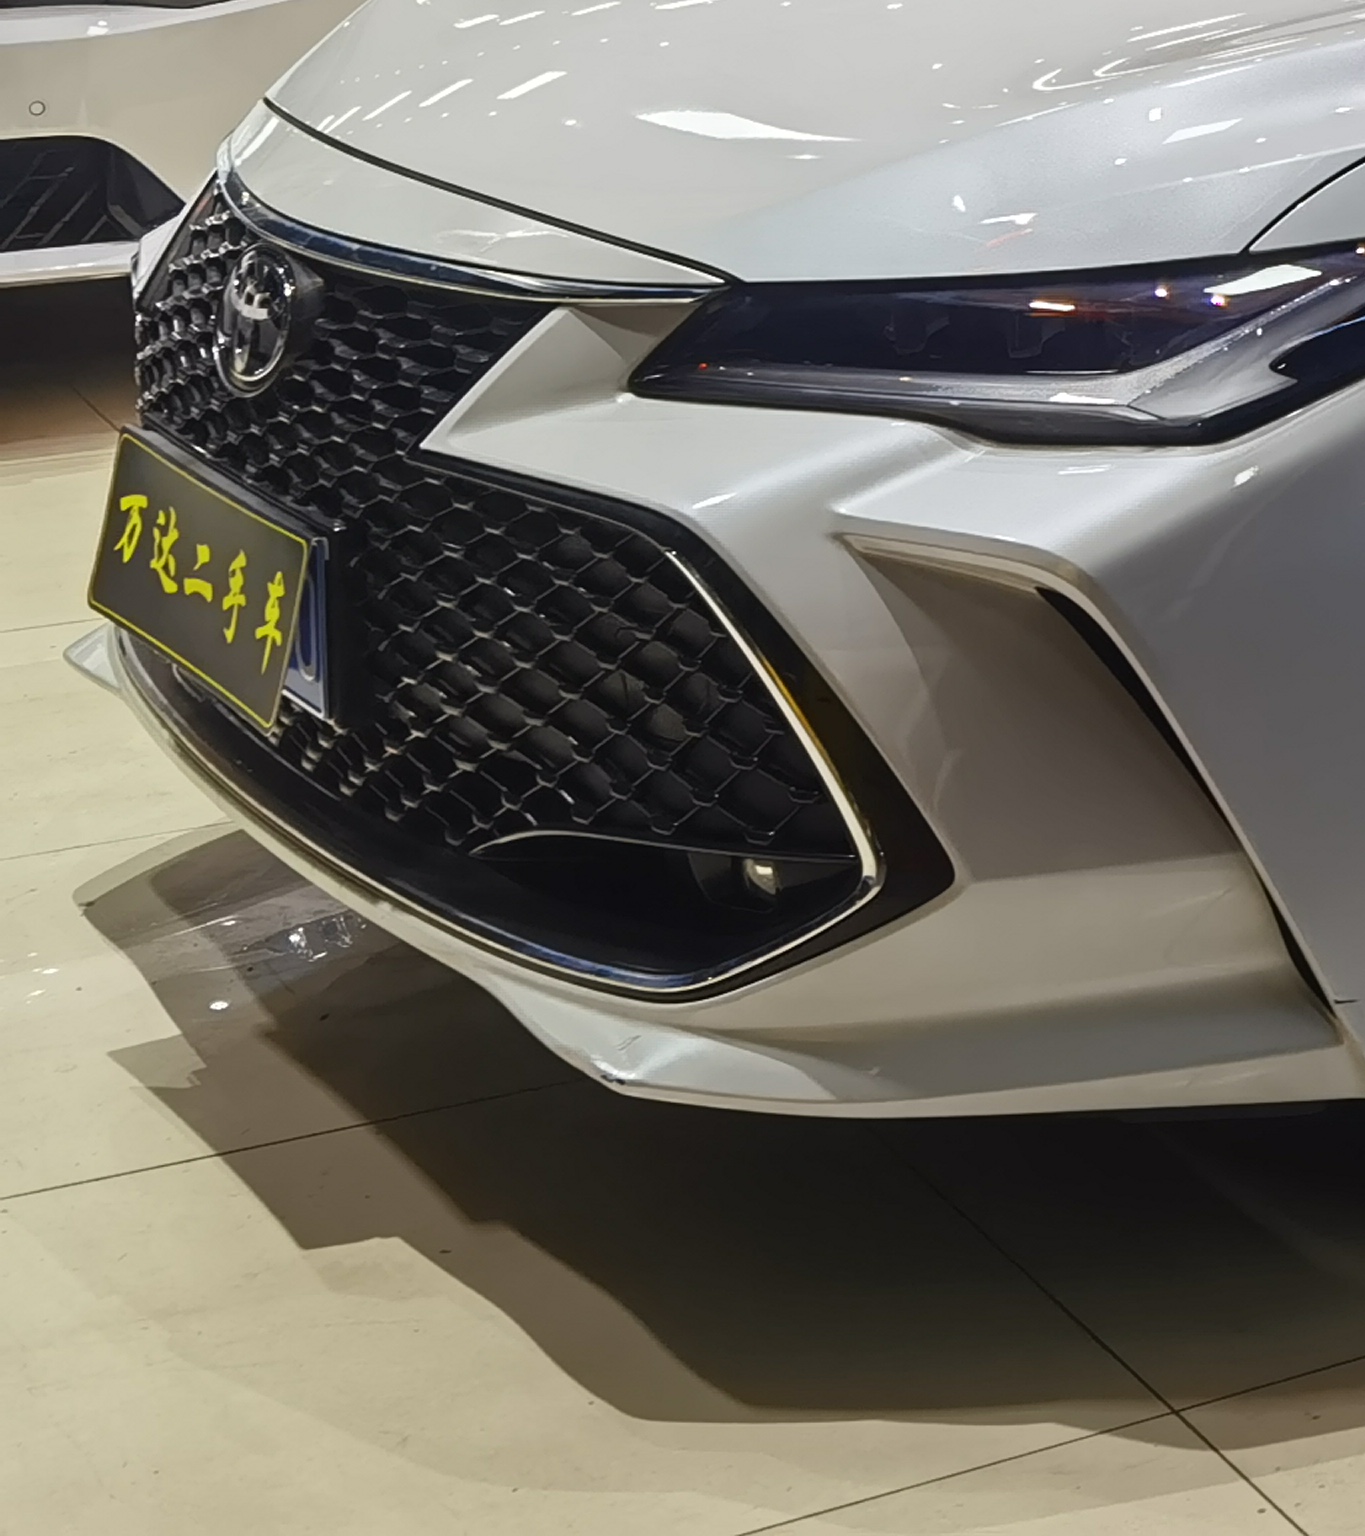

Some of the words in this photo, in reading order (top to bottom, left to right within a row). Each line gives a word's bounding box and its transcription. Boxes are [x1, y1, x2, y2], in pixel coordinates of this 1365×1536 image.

[114, 495, 286, 674] 万达二手车
